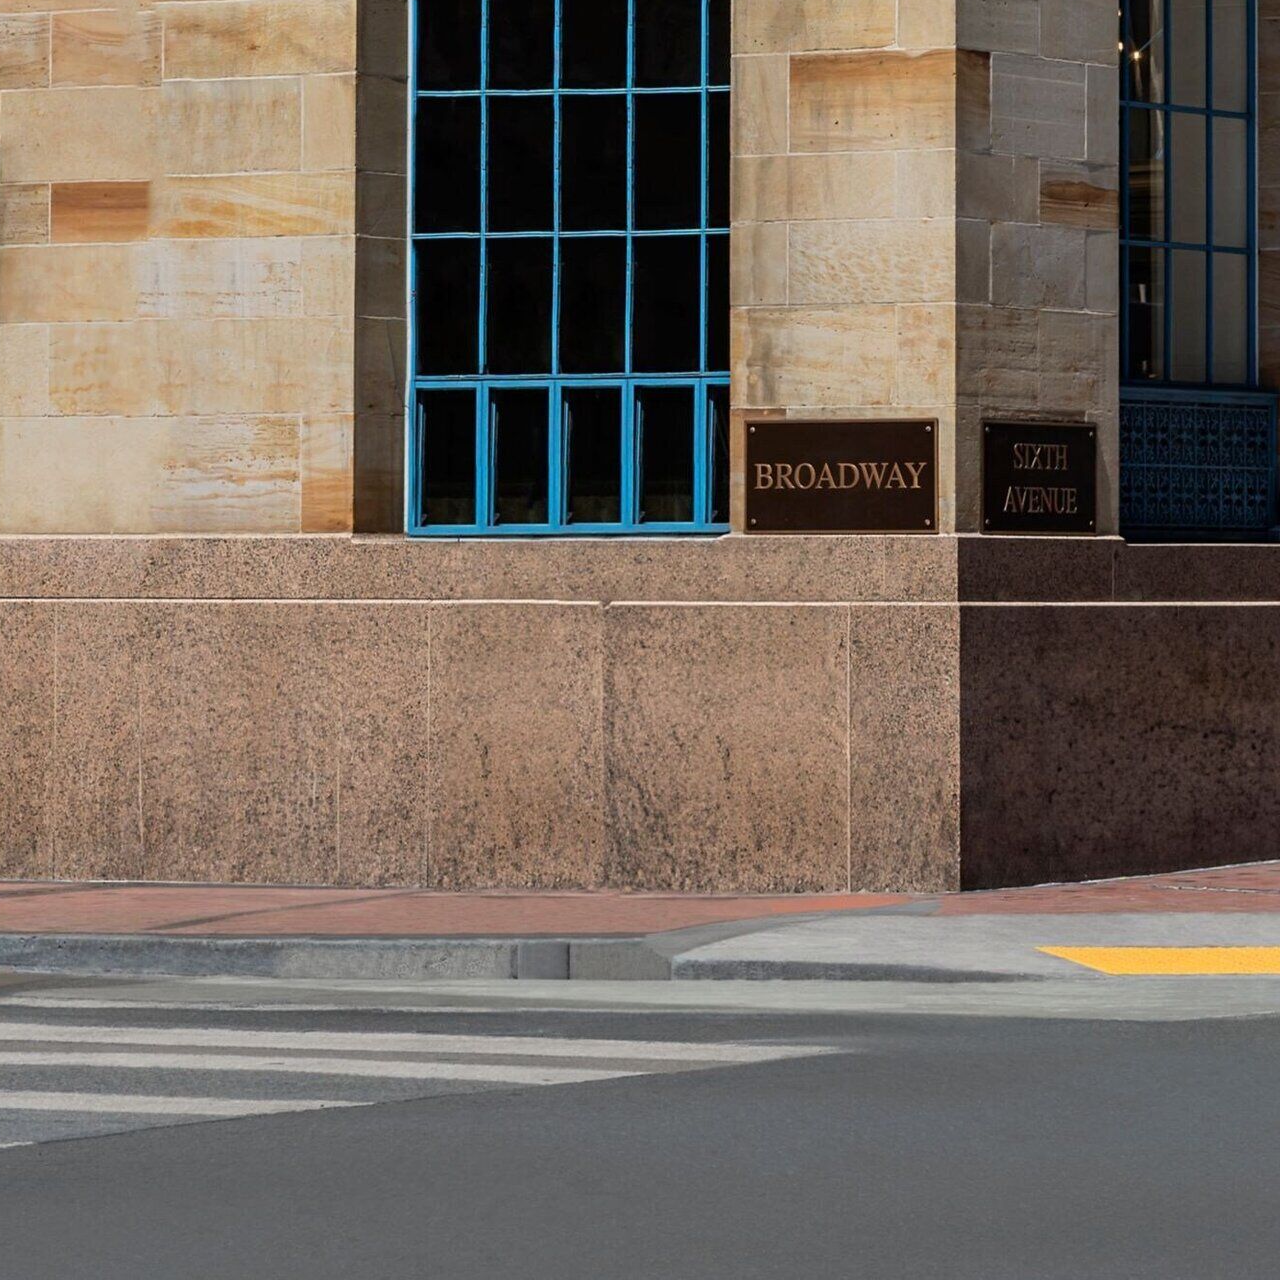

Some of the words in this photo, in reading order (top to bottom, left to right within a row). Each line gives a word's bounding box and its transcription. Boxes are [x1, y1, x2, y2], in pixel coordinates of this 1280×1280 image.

[1013, 443, 1069, 470] SIXTH
[754, 462, 927, 490] BROADWAY
[1003, 485, 1078, 514] AVENUE
